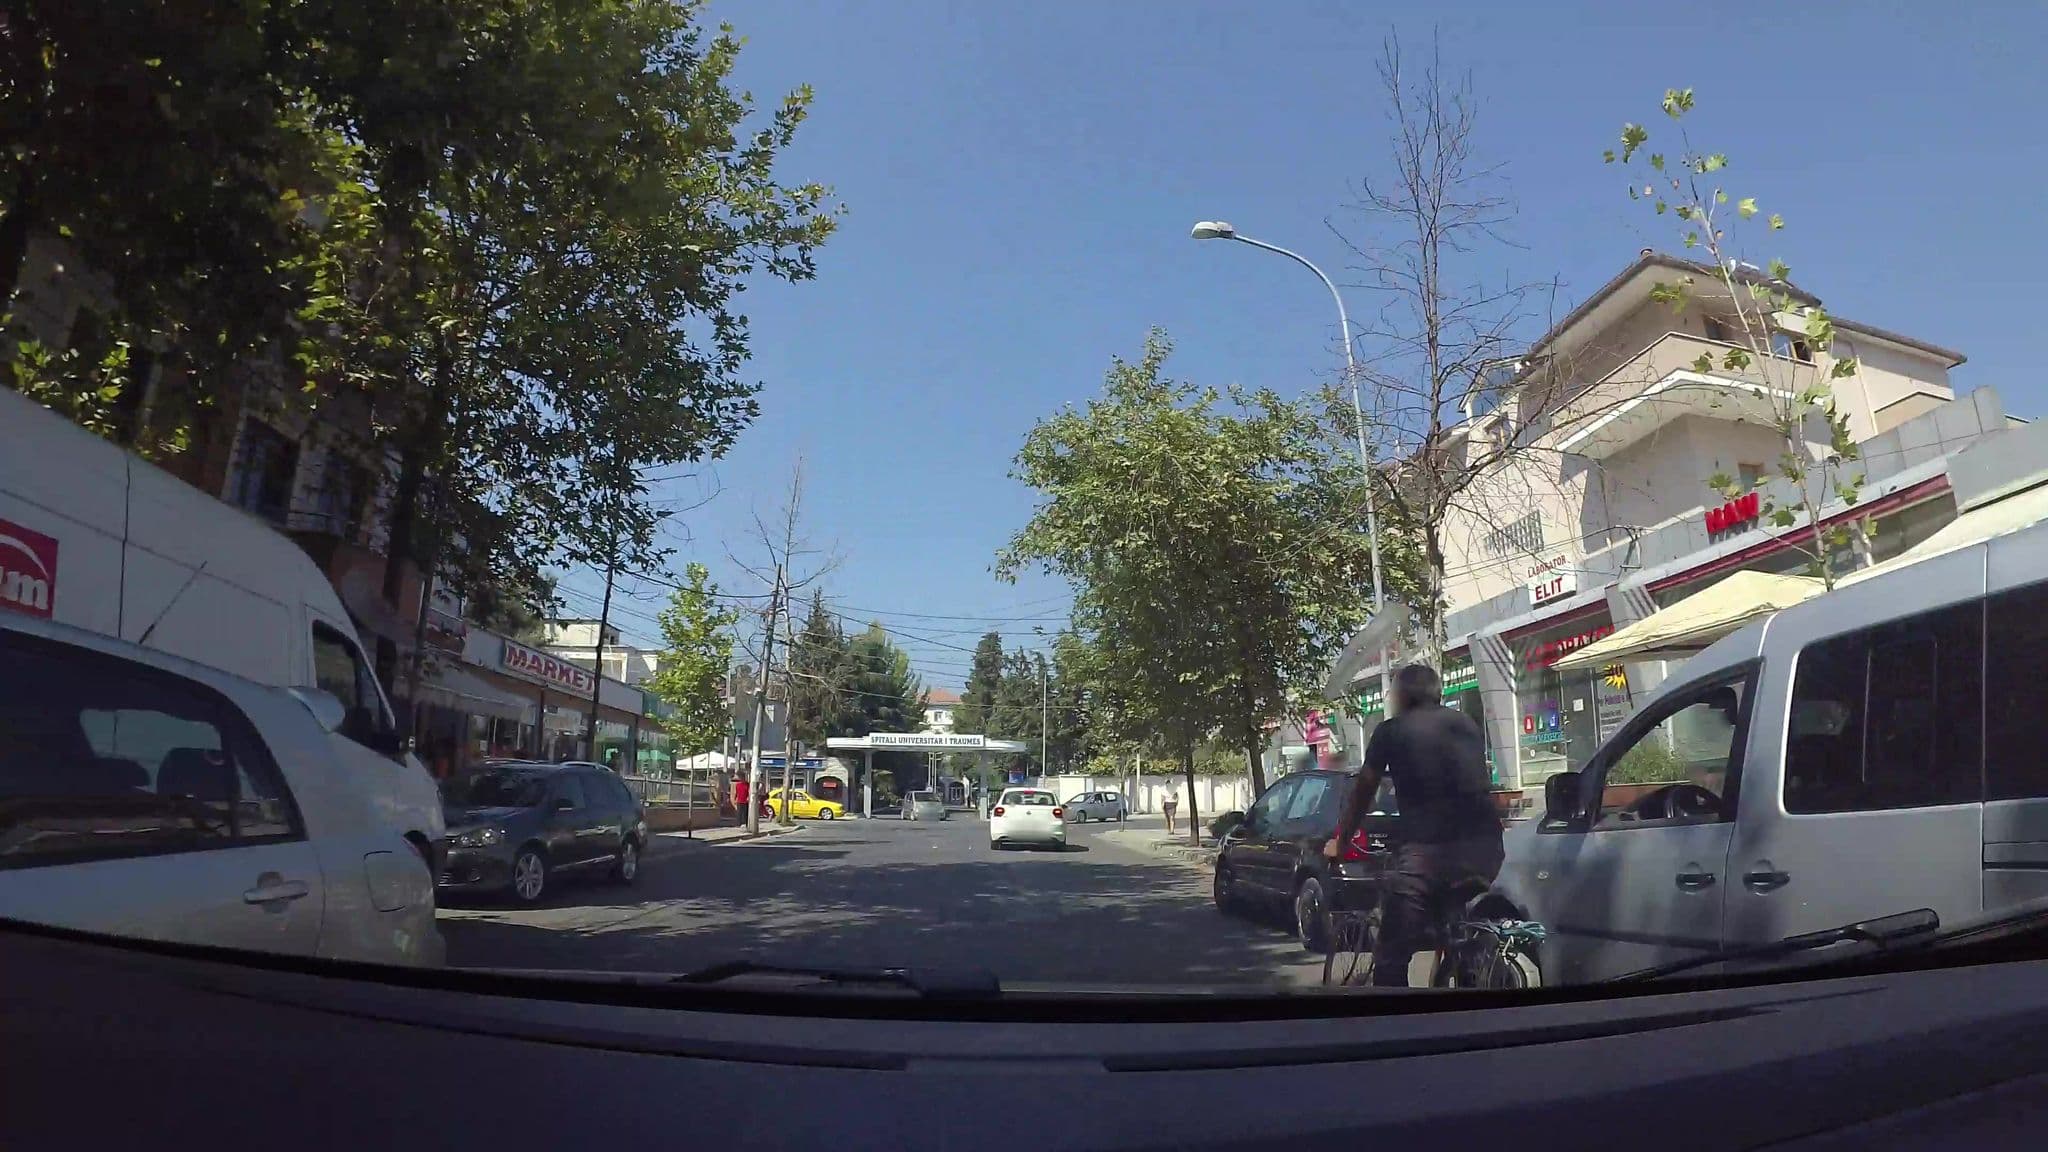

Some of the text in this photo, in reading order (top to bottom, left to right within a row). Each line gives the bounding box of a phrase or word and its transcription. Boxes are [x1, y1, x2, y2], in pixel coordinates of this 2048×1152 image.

[1527, 555, 1567, 578] LABORATOR
[1535, 577, 1563, 601] ELIT
[506, 645, 596, 691] MARKET
[871, 736, 896, 744] SPITALI
[899, 736, 943, 745] UNIVERSITAR
